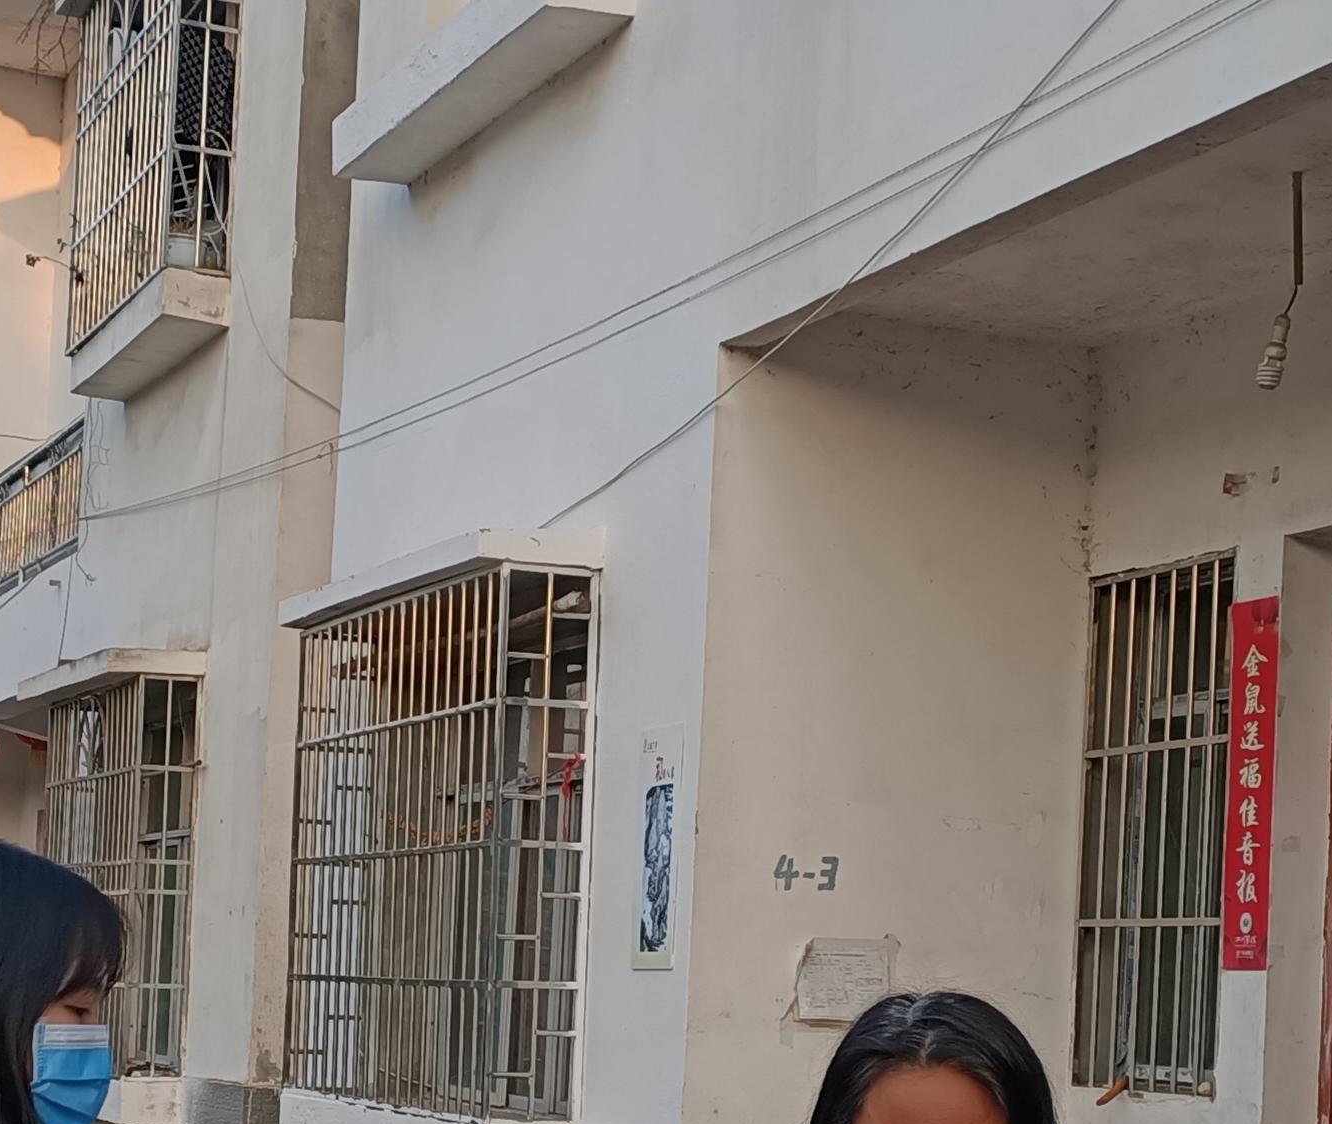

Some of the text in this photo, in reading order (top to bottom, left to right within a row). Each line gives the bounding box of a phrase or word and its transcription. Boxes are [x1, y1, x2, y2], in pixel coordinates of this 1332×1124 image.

[1236, 644, 1269, 904] 金鼠送福佳音报
[773, 854, 839, 891] 4-3
